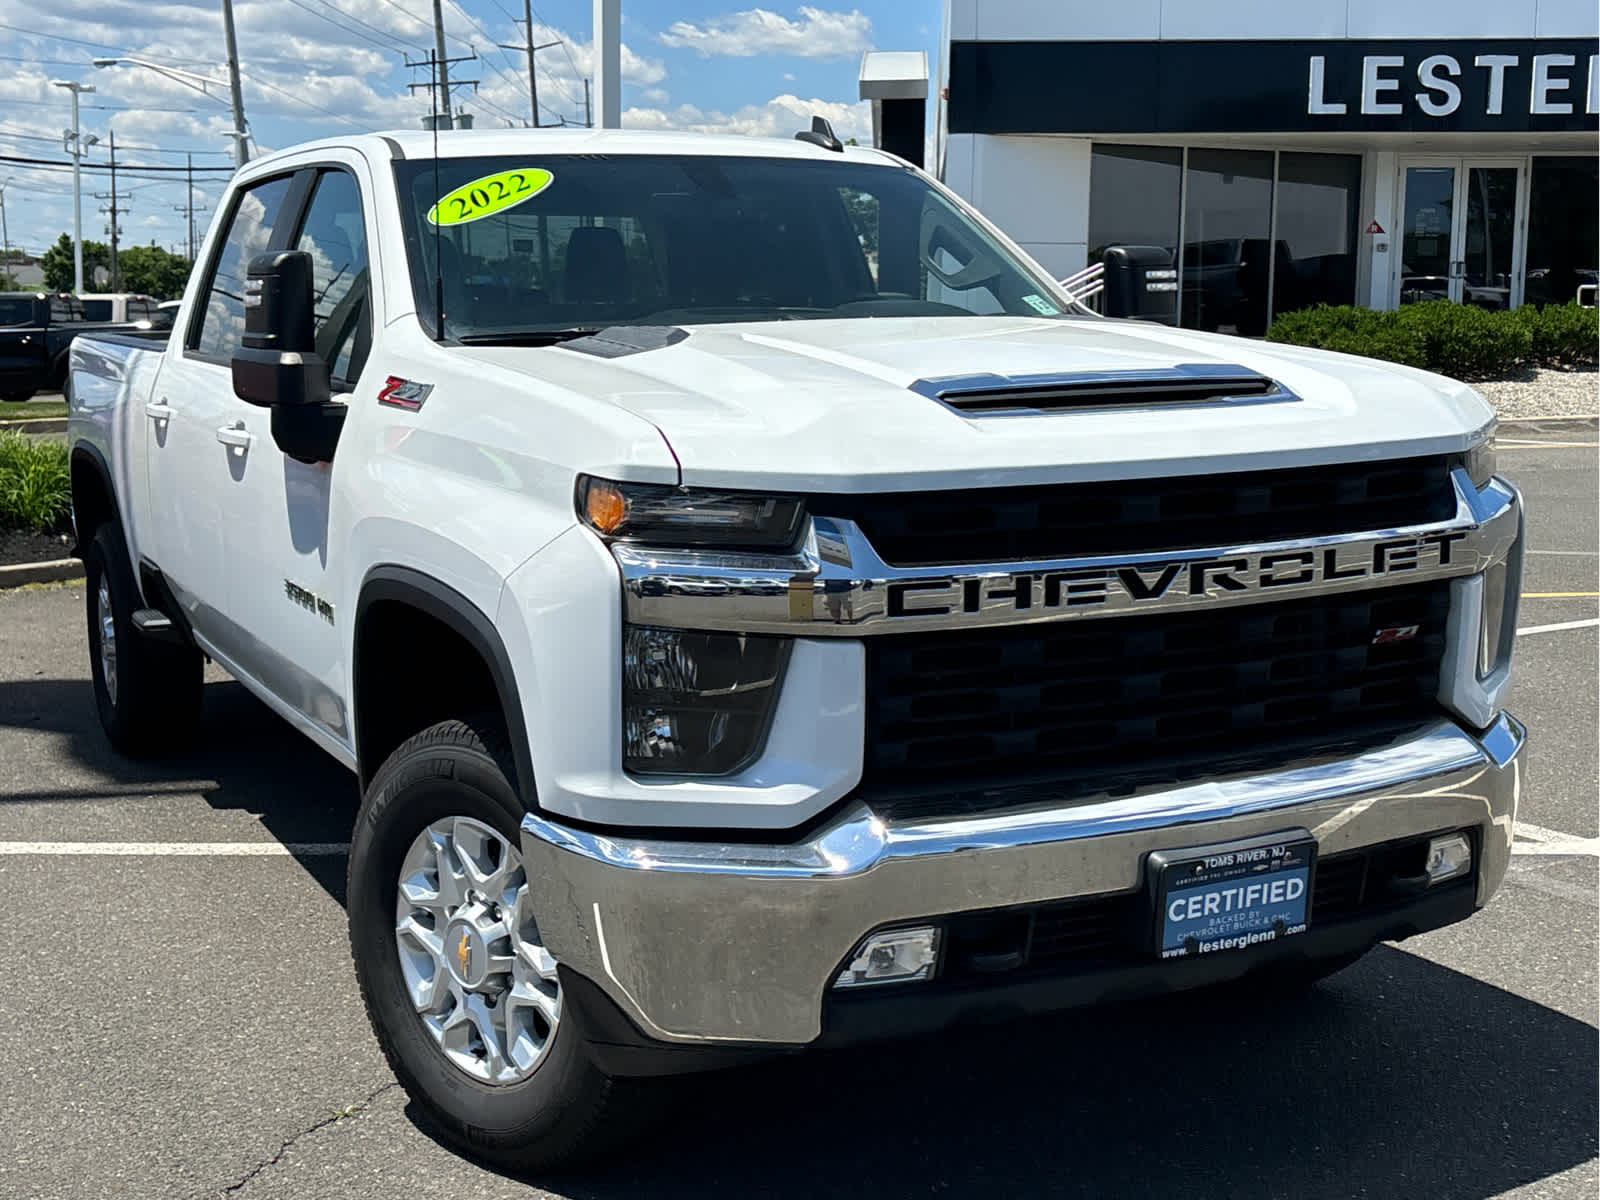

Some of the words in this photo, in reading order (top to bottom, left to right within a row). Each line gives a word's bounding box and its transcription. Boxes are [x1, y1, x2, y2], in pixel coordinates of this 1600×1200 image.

[449, 174, 531, 219] 2022
[887, 532, 1467, 618] CHEVROLET
[1205, 855, 1234, 869] TOMS
[1271, 846, 1286, 858] NJ
[1168, 878, 1304, 922] CERTIFIED
[1208, 912, 1246, 927] BACKED
[1233, 918, 1260, 931] BUICK
[1198, 929, 1276, 953] lesterglenn
